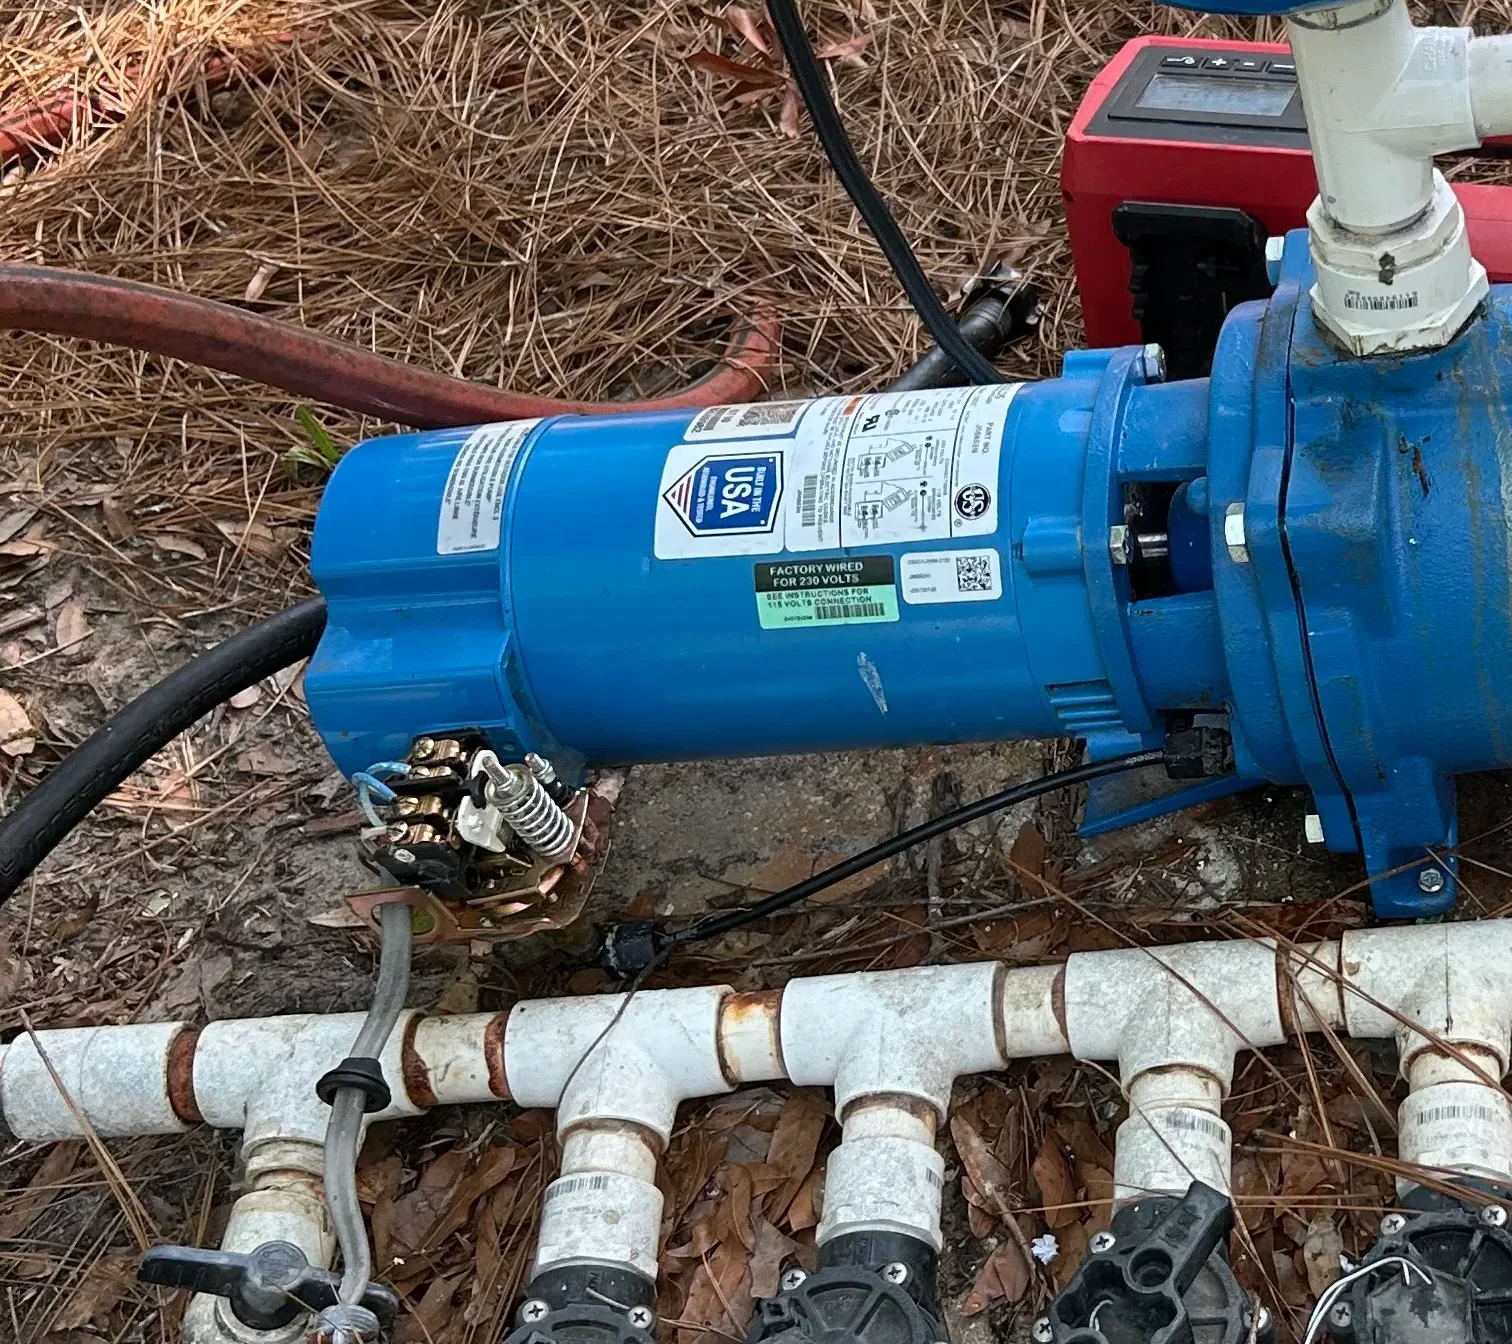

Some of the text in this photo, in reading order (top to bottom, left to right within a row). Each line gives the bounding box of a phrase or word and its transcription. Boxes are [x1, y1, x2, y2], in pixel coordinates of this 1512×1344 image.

[984, 421, 994, 444] PART
[755, 466, 767, 487] BUILT
[719, 466, 756, 519] USA
[750, 496, 762, 513] THE
[769, 560, 864, 577] FACTORY WIRED
[773, 573, 860, 588] FOR 230 VOLTS
[766, 587, 869, 601] SEE INSTRUCTIONS FOR
[767, 595, 872, 609] 115 VOLTS CONNECTION
